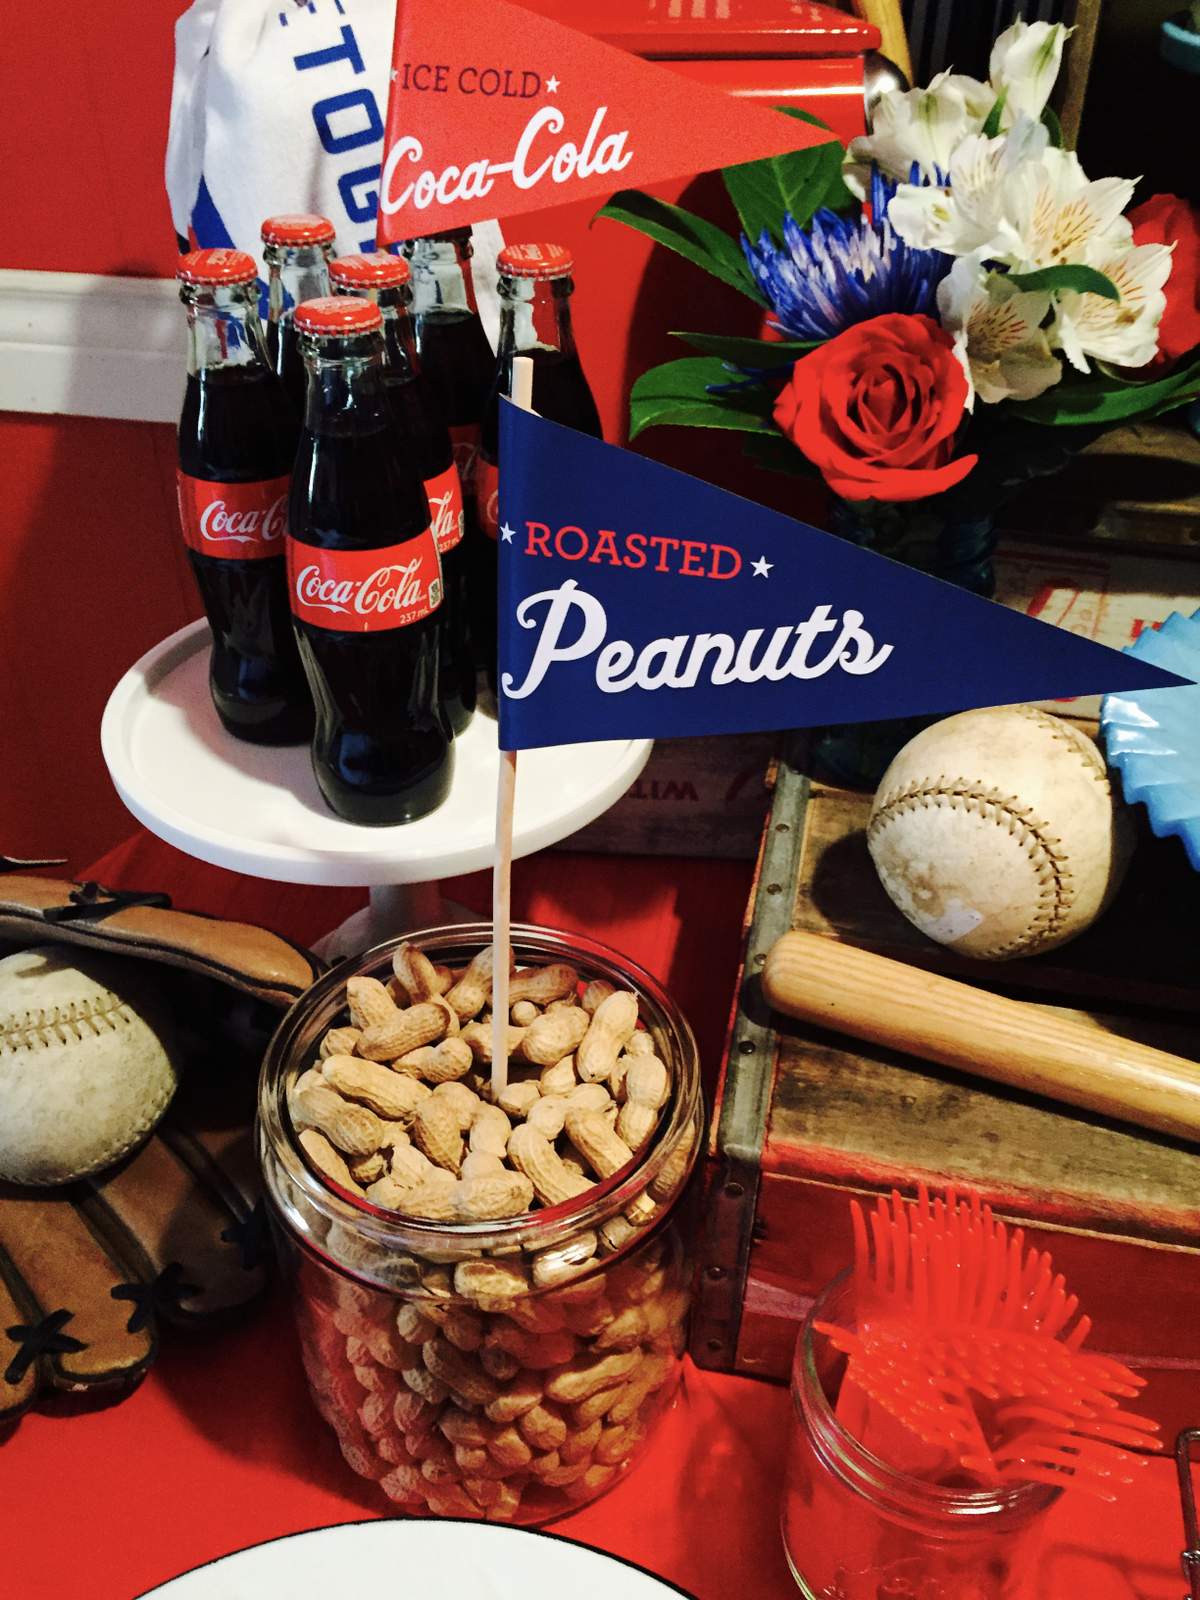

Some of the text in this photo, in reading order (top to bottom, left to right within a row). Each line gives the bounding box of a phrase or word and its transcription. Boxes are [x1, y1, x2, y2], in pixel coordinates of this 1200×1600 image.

[401, 63, 542, 99] ICE COLD
[278, 0, 401, 254] TOG
[380, 105, 634, 216] Coca-Cola
[200, 493, 288, 543] Coca-C
[524, 521, 743, 581] ROASTED
[296, 555, 427, 615] Coca-Cola
[400, 610, 416, 625] 237
[501, 578, 894, 700] Peanuts
[628, 780, 699, 801] WIT
